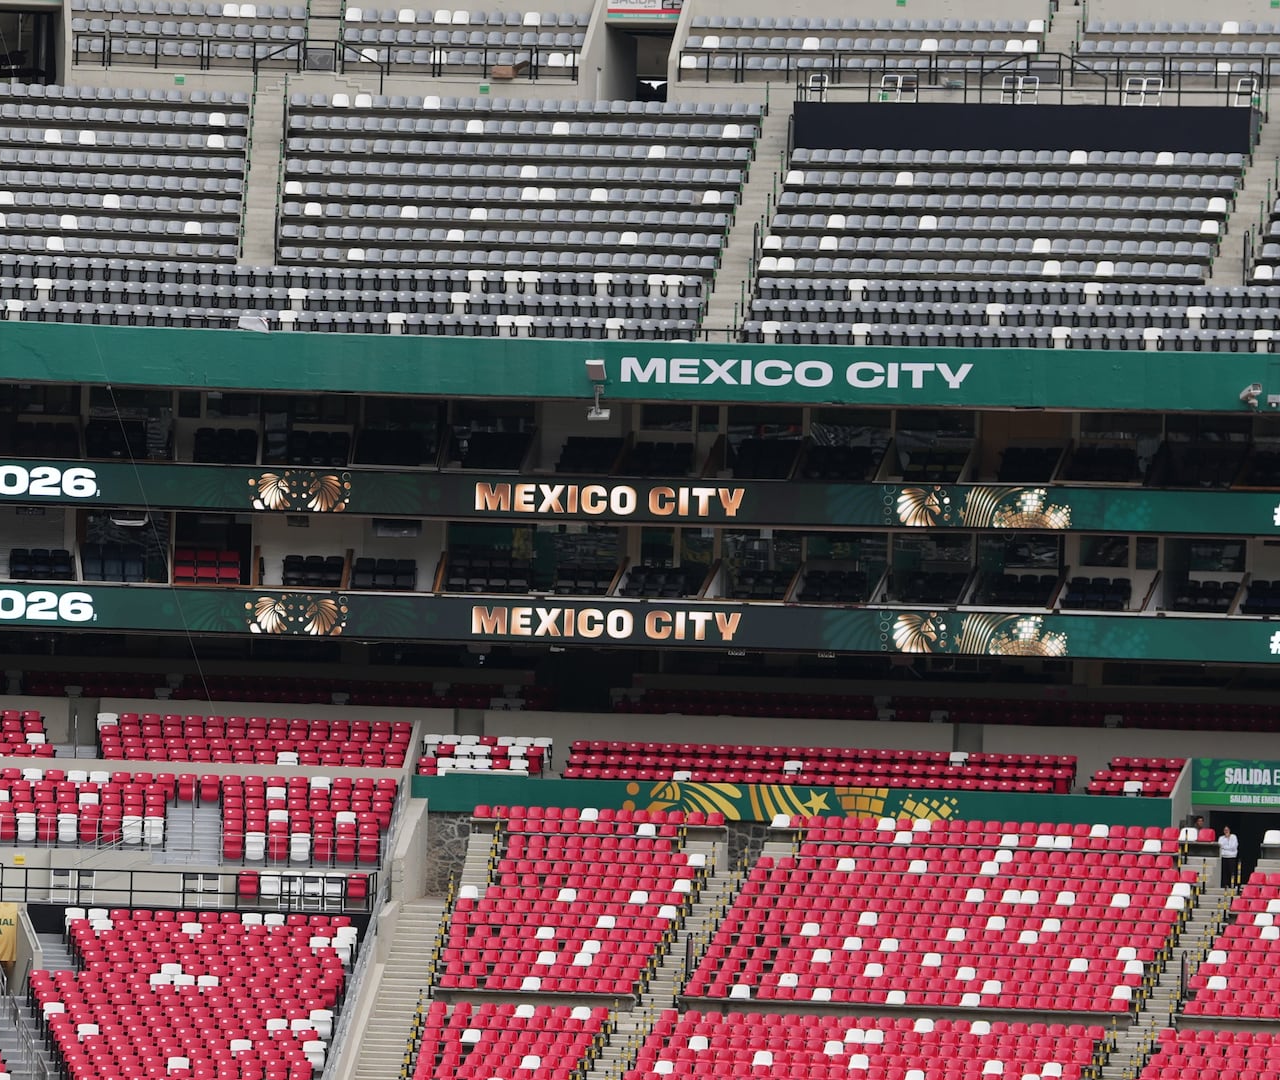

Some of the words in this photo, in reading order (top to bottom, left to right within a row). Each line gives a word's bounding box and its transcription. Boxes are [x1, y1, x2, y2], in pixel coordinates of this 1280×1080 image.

[621, 357, 834, 387] MEXICO
[847, 361, 974, 389] CITY
[474, 482, 637, 516] MEXICO
[648, 486, 745, 517] CITY
[471, 605, 634, 639] MEXICO
[644, 610, 742, 641] CITY
[1224, 768, 1271, 785] SALIDA
[1230, 795, 1252, 803] SALIDA
[1252, 795, 1261, 804] DE
